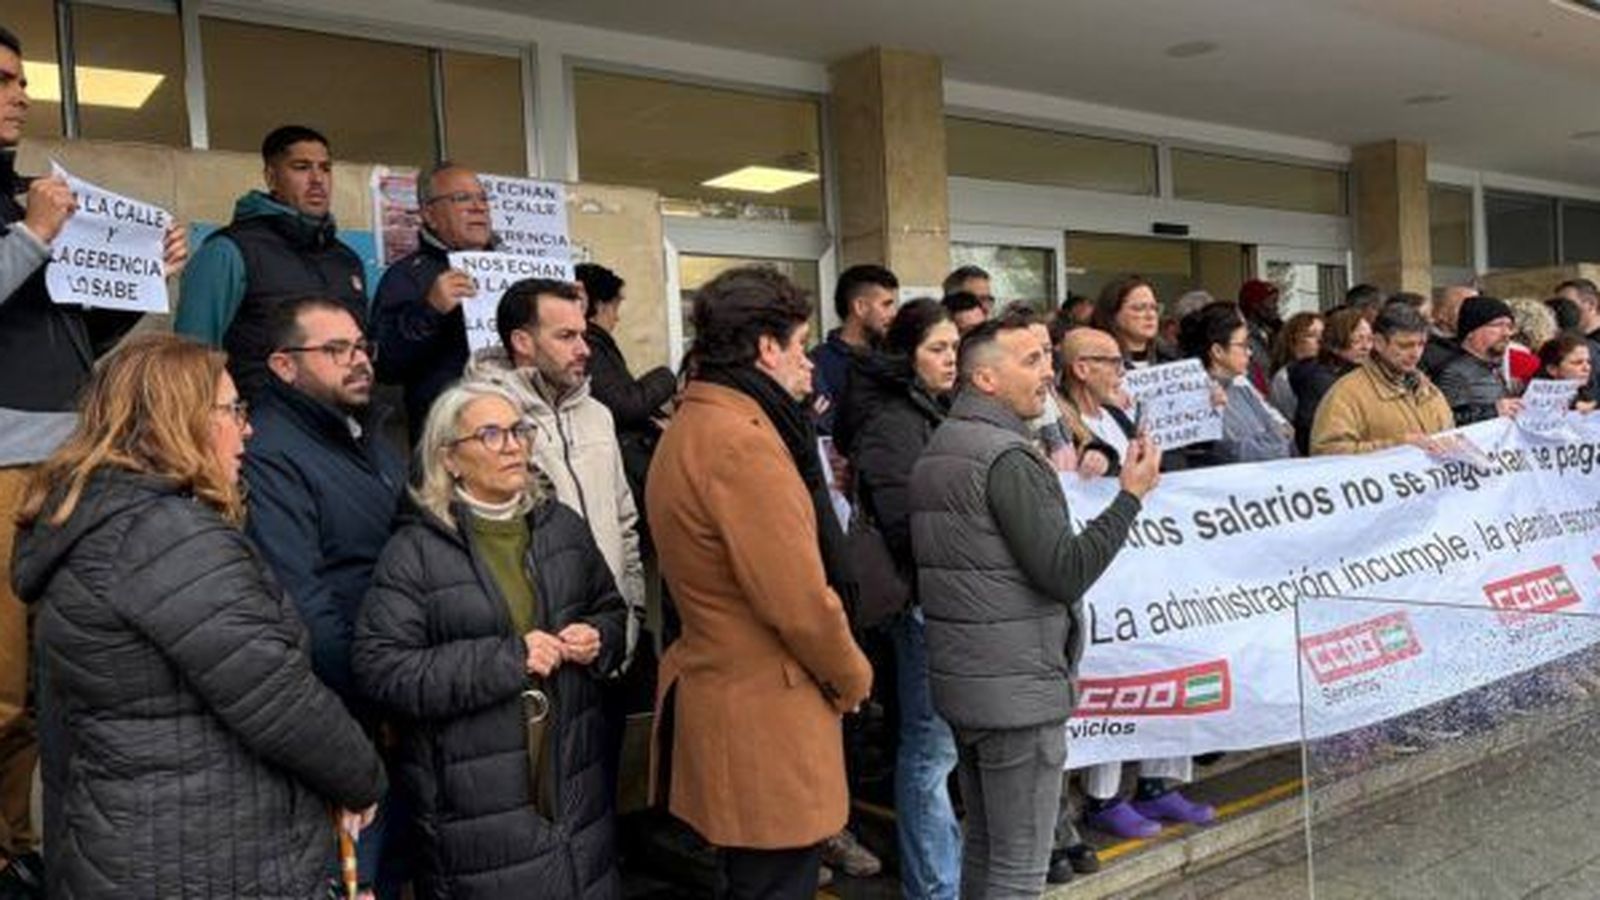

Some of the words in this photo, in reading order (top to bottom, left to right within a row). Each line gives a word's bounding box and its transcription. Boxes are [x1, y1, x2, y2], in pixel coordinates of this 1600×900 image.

[496, 181, 555, 199] ECHAN
[85, 194, 110, 216] LA
[114, 200, 164, 229] CALLE
[502, 199, 556, 215] CALLE
[505, 215, 514, 226] Y
[106, 226, 119, 243] Y
[503, 229, 568, 247] RENCIA
[49, 245, 70, 264] LA
[74, 249, 162, 277] GERENCIA
[462, 257, 504, 272] NOS
[507, 260, 566, 278] ECHAN
[92, 278, 138, 301] SABE
[486, 278, 510, 292] LA
[1127, 371, 1159, 389] NOS
[1192, 485, 1335, 540] salarios
[1340, 477, 1384, 509] no
[1389, 471, 1427, 497] se
[1088, 602, 1138, 646] La
[1147, 566, 1341, 635] administración
[1339, 532, 1481, 590] incumple,
[1474, 521, 1505, 552] la
[1078, 681, 1177, 710] COO
[1069, 717, 1137, 740] vicios
